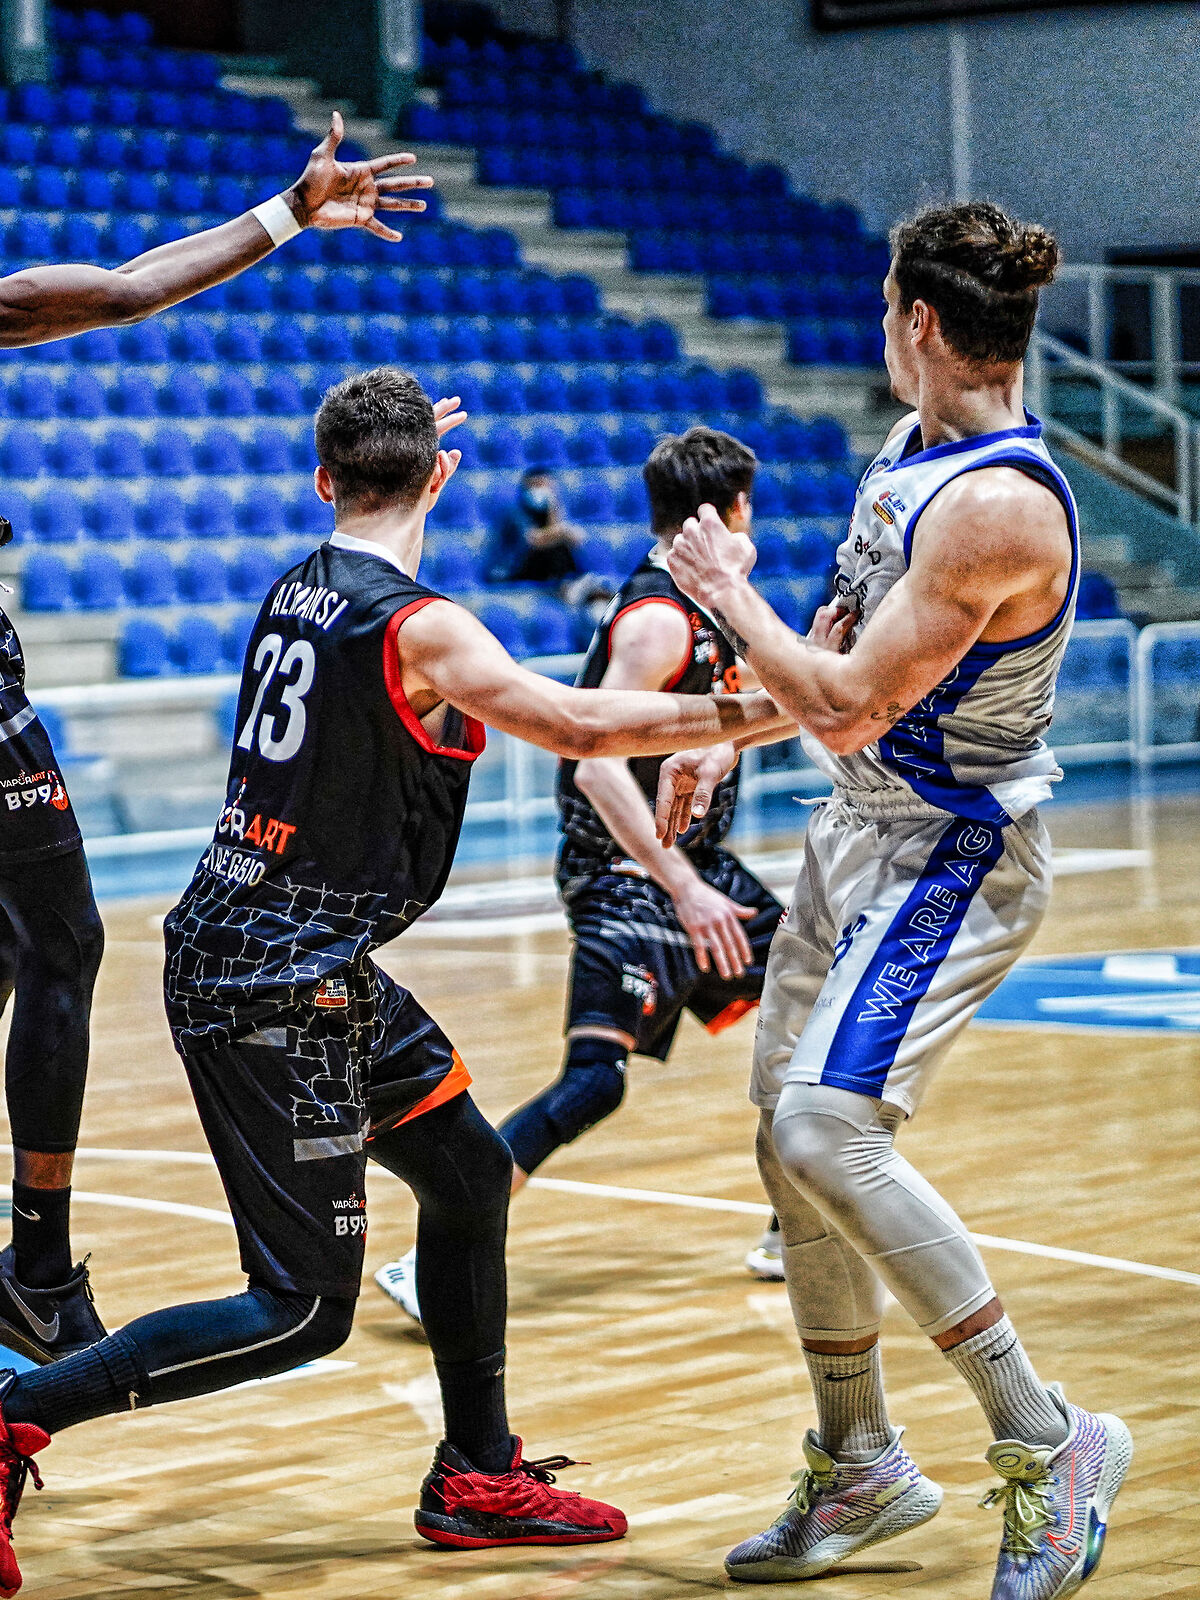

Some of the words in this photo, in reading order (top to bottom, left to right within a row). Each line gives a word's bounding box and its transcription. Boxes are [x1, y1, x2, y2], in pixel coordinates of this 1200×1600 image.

[237, 633, 316, 762] 23
[0, 770, 46, 788] VAPORART
[5, 783, 51, 811] B99
[857, 962, 918, 1024] WE
[899, 884, 958, 964] ARE
